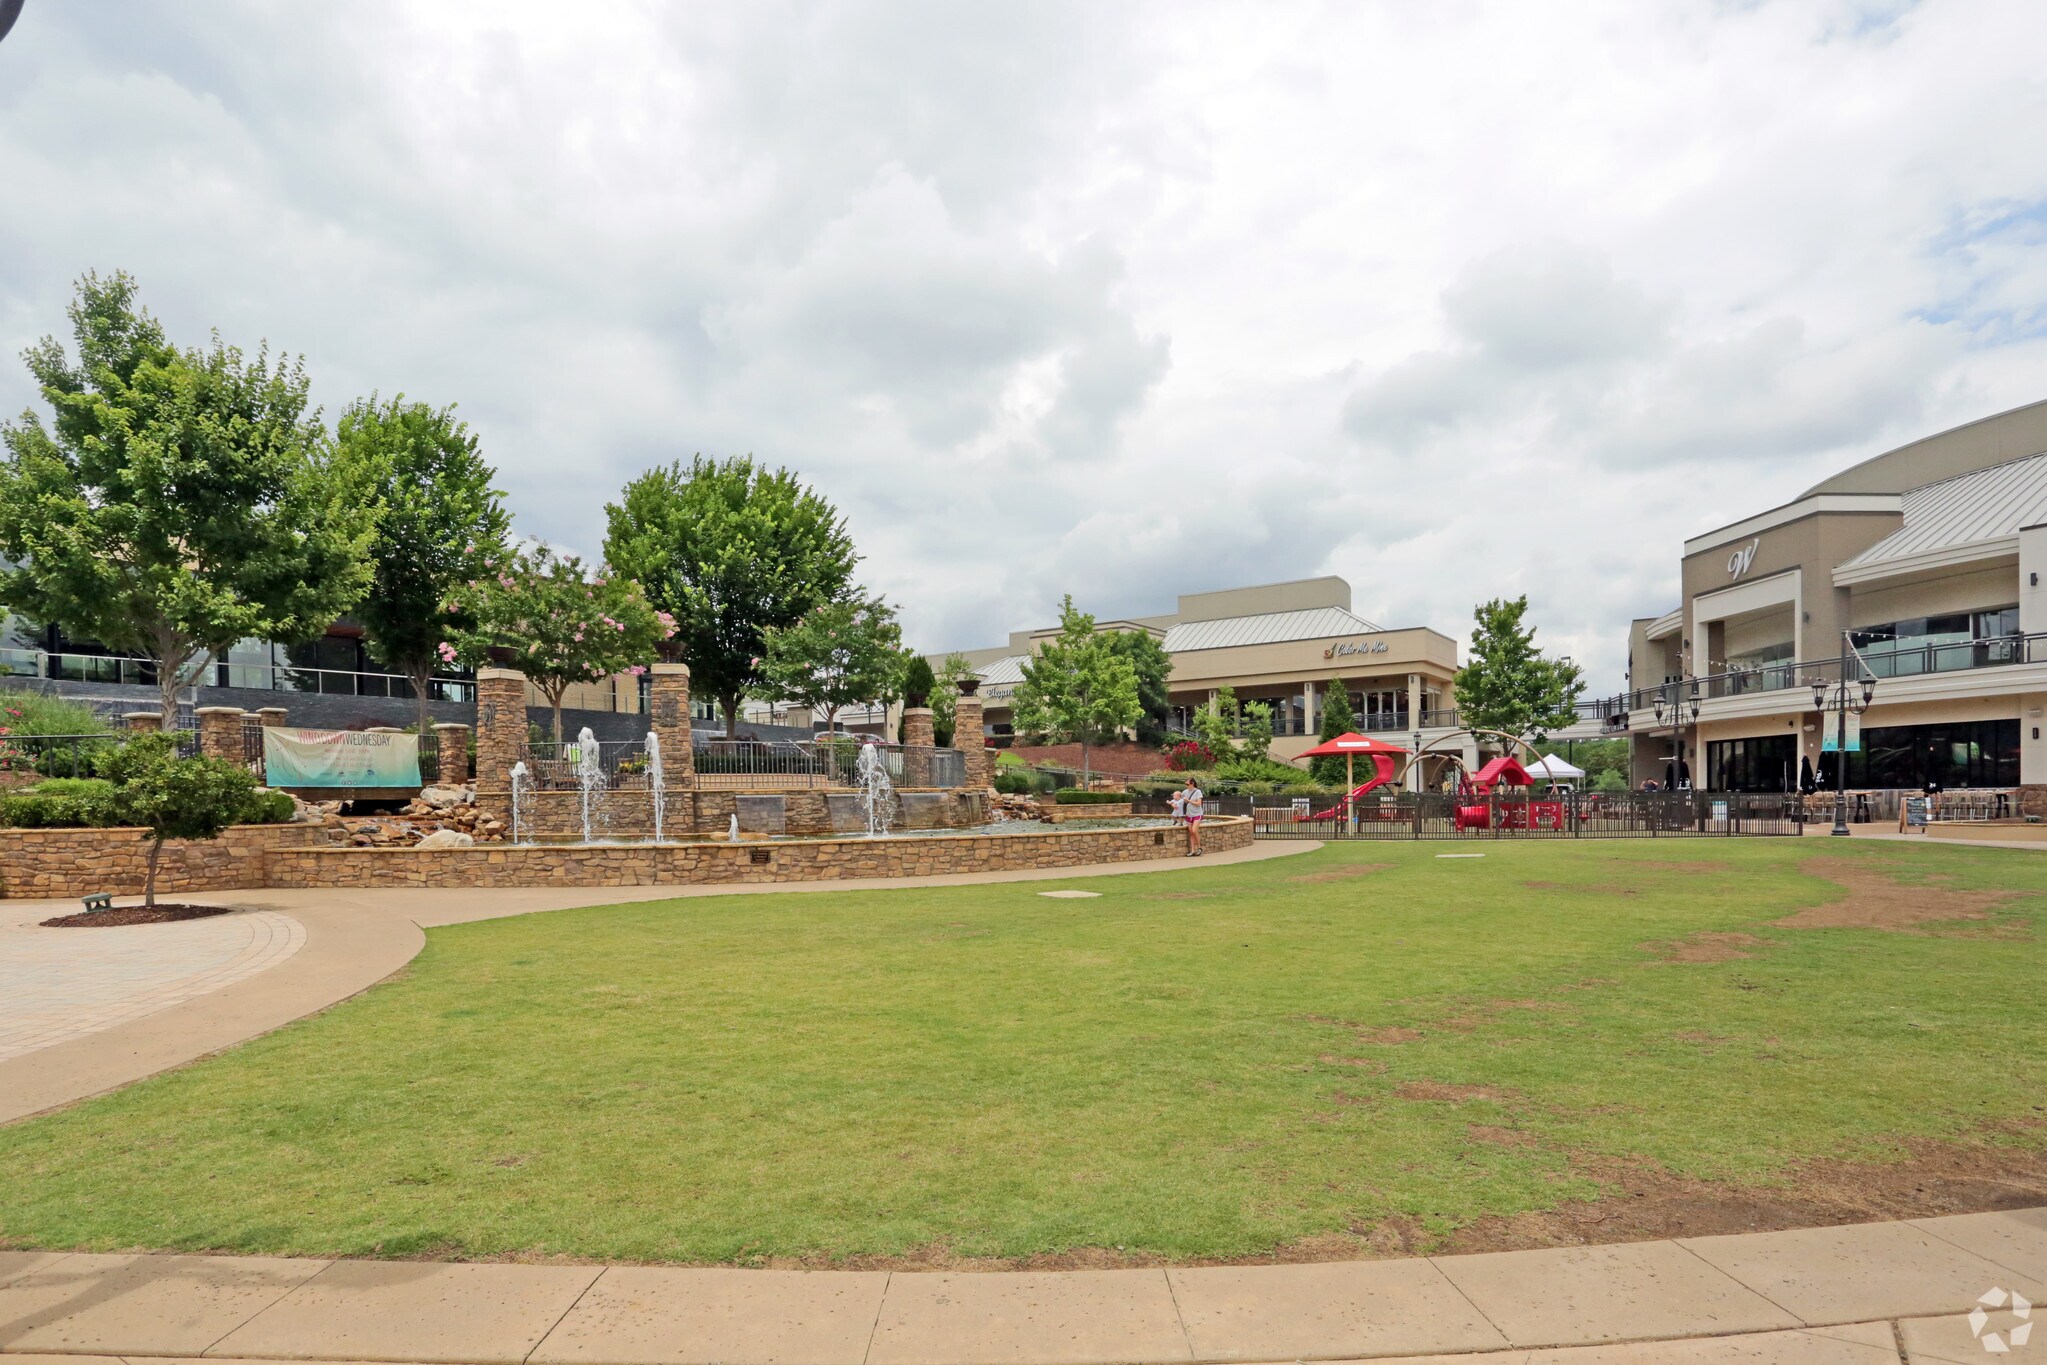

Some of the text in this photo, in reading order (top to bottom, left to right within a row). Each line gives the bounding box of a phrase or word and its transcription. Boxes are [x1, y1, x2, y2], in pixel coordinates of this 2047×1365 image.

[1727, 538, 1759, 580] W
[1338, 640, 1389, 656] Color Me Mine
[297, 730, 391, 746] WIND DOWN WEDNESDAY
